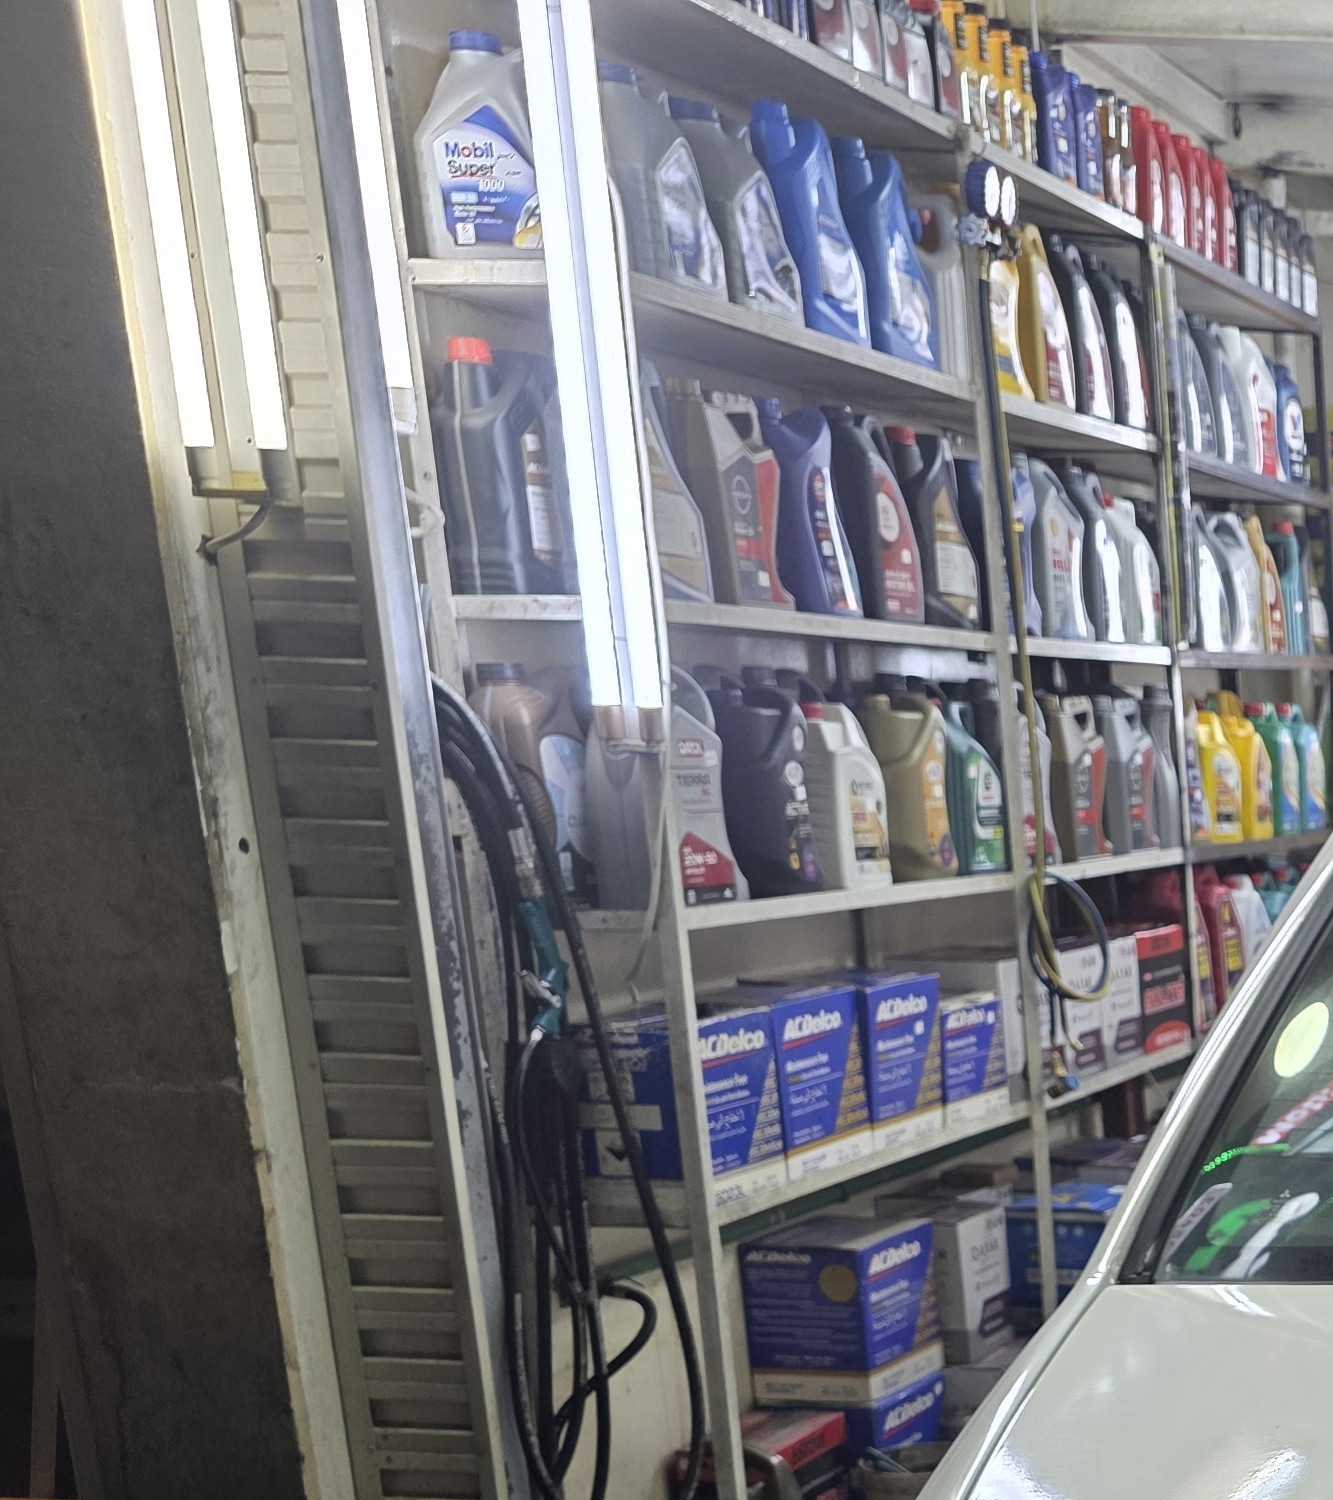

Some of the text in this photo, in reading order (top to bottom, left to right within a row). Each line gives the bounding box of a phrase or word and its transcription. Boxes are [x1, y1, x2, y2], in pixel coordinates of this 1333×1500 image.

[444, 140, 495, 159] Mobil
[447, 159, 497, 177] Super
[876, 992, 929, 1025] ACDelco
[945, 1007, 987, 1031] ACDelco
[782, 1008, 844, 1045] ACDelco
[868, 1239, 922, 1276] ACDelco
[882, 1390, 935, 1433] ACDelco
